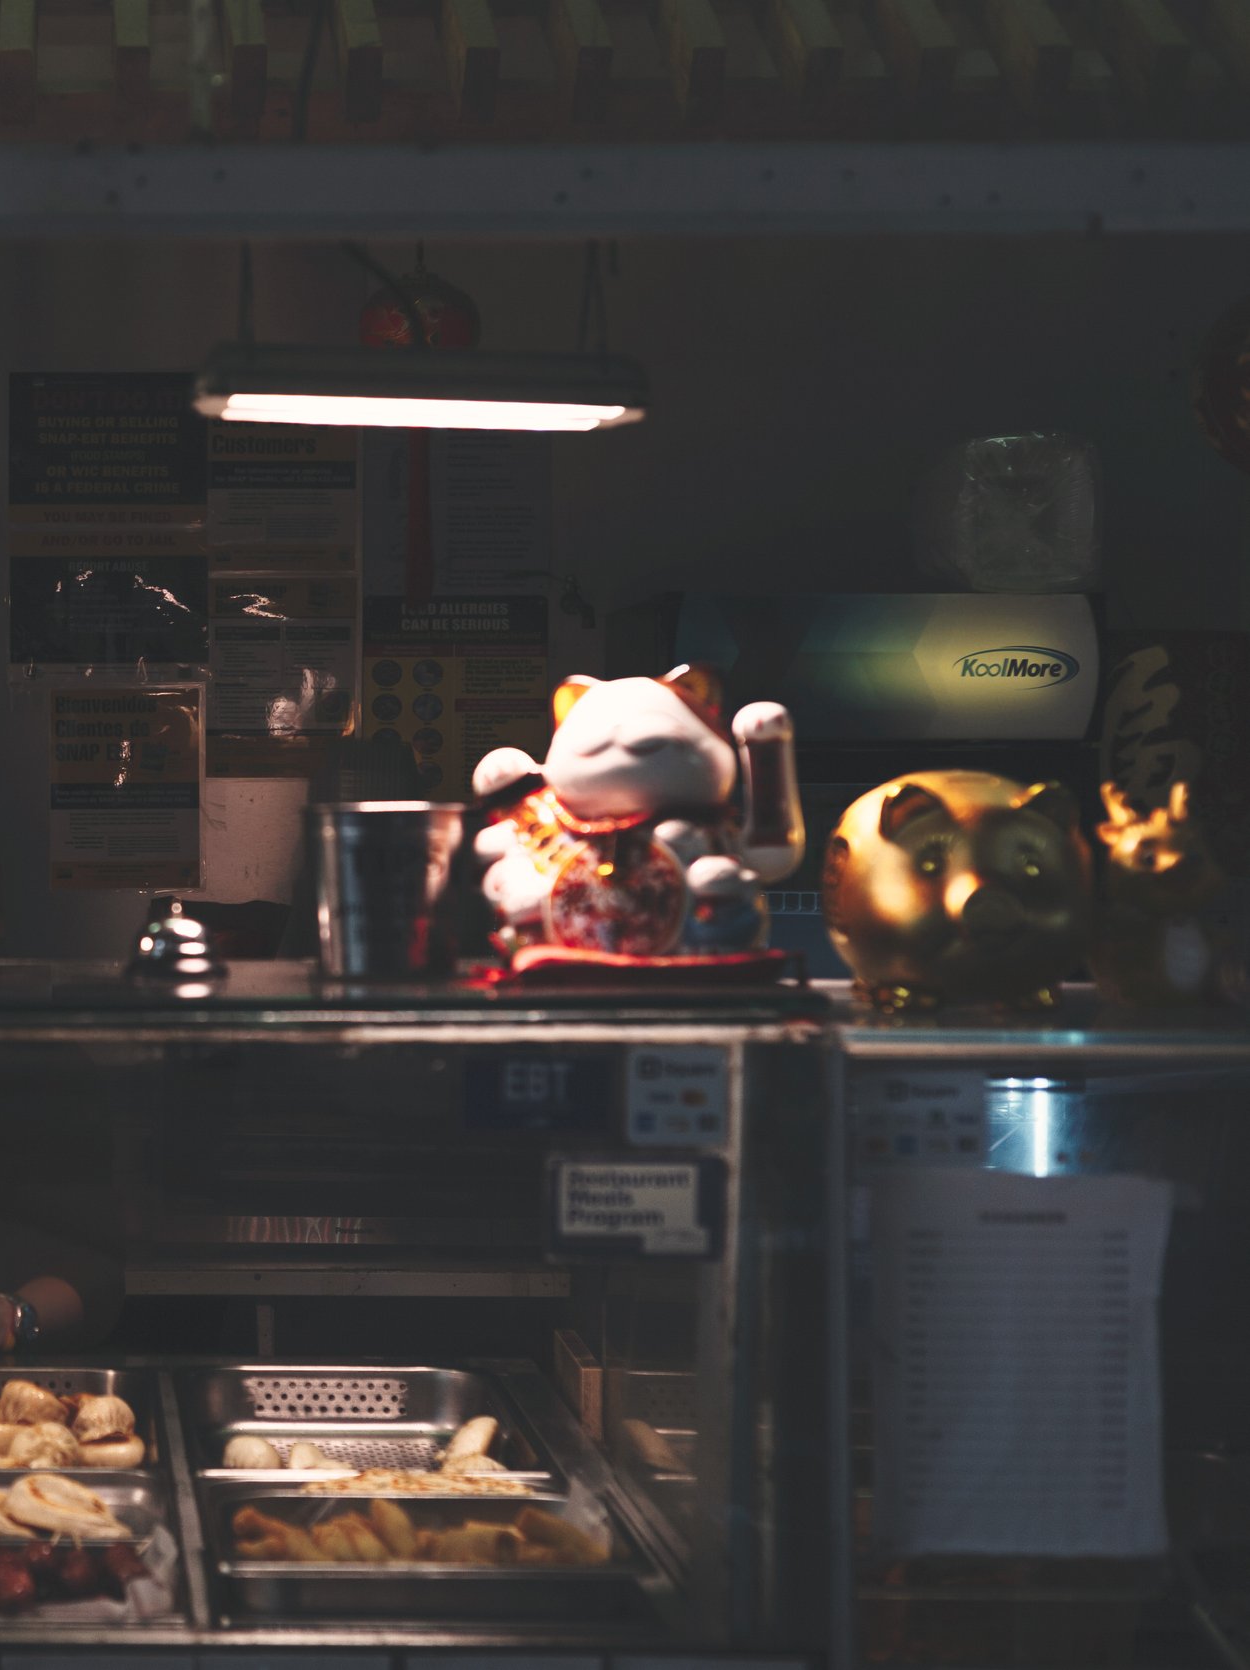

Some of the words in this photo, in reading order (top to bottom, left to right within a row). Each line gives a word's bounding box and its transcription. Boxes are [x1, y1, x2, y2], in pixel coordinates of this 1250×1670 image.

[38, 417, 91, 428] BUYING
[95, 417, 116, 428] OR
[118, 417, 179, 428] SELLING
[38, 433, 107, 444] SNAP-EBT
[111, 433, 178, 444] BENEFITS
[212, 434, 317, 454] Customers
[46, 465, 67, 477] OR
[71, 465, 100, 477] WIC
[102, 465, 170, 477] BENEFITS
[35, 482, 50, 494] IS
[52, 482, 63, 494] A
[67, 482, 130, 494] FEDERAL
[134, 482, 181, 494] CRIME
[44, 511, 73, 523] YOU
[76, 511, 105, 523] MAY
[111, 511, 128, 523] BE
[131, 511, 172, 523] FINED
[41, 535, 100, 546] AND/OR
[102, 535, 123, 546] GO
[126, 535, 144, 546] TO
[148, 535, 176, 546] JAIL
[68, 561, 111, 572] REPORT
[112, 561, 150, 572] ABUSE
[401, 603, 436, 615] FD
[439, 603, 510, 615] ALLERGIES
[401, 618, 430, 630] CAN
[432, 618, 449, 630] BE
[451, 618, 510, 630] SERIOUS
[961, 658, 1063, 678] KoolMore
[55, 696, 158, 714] Bienvenidos
[55, 719, 123, 737] Clientes
[129, 719, 149, 737] de
[55, 743, 100, 761] SNAP
[504, 1062, 570, 1102] EBT
[569, 1171, 690, 1187] Restaurant
[569, 1191, 634, 1206] Meals
[569, 1209, 665, 1231] Program
